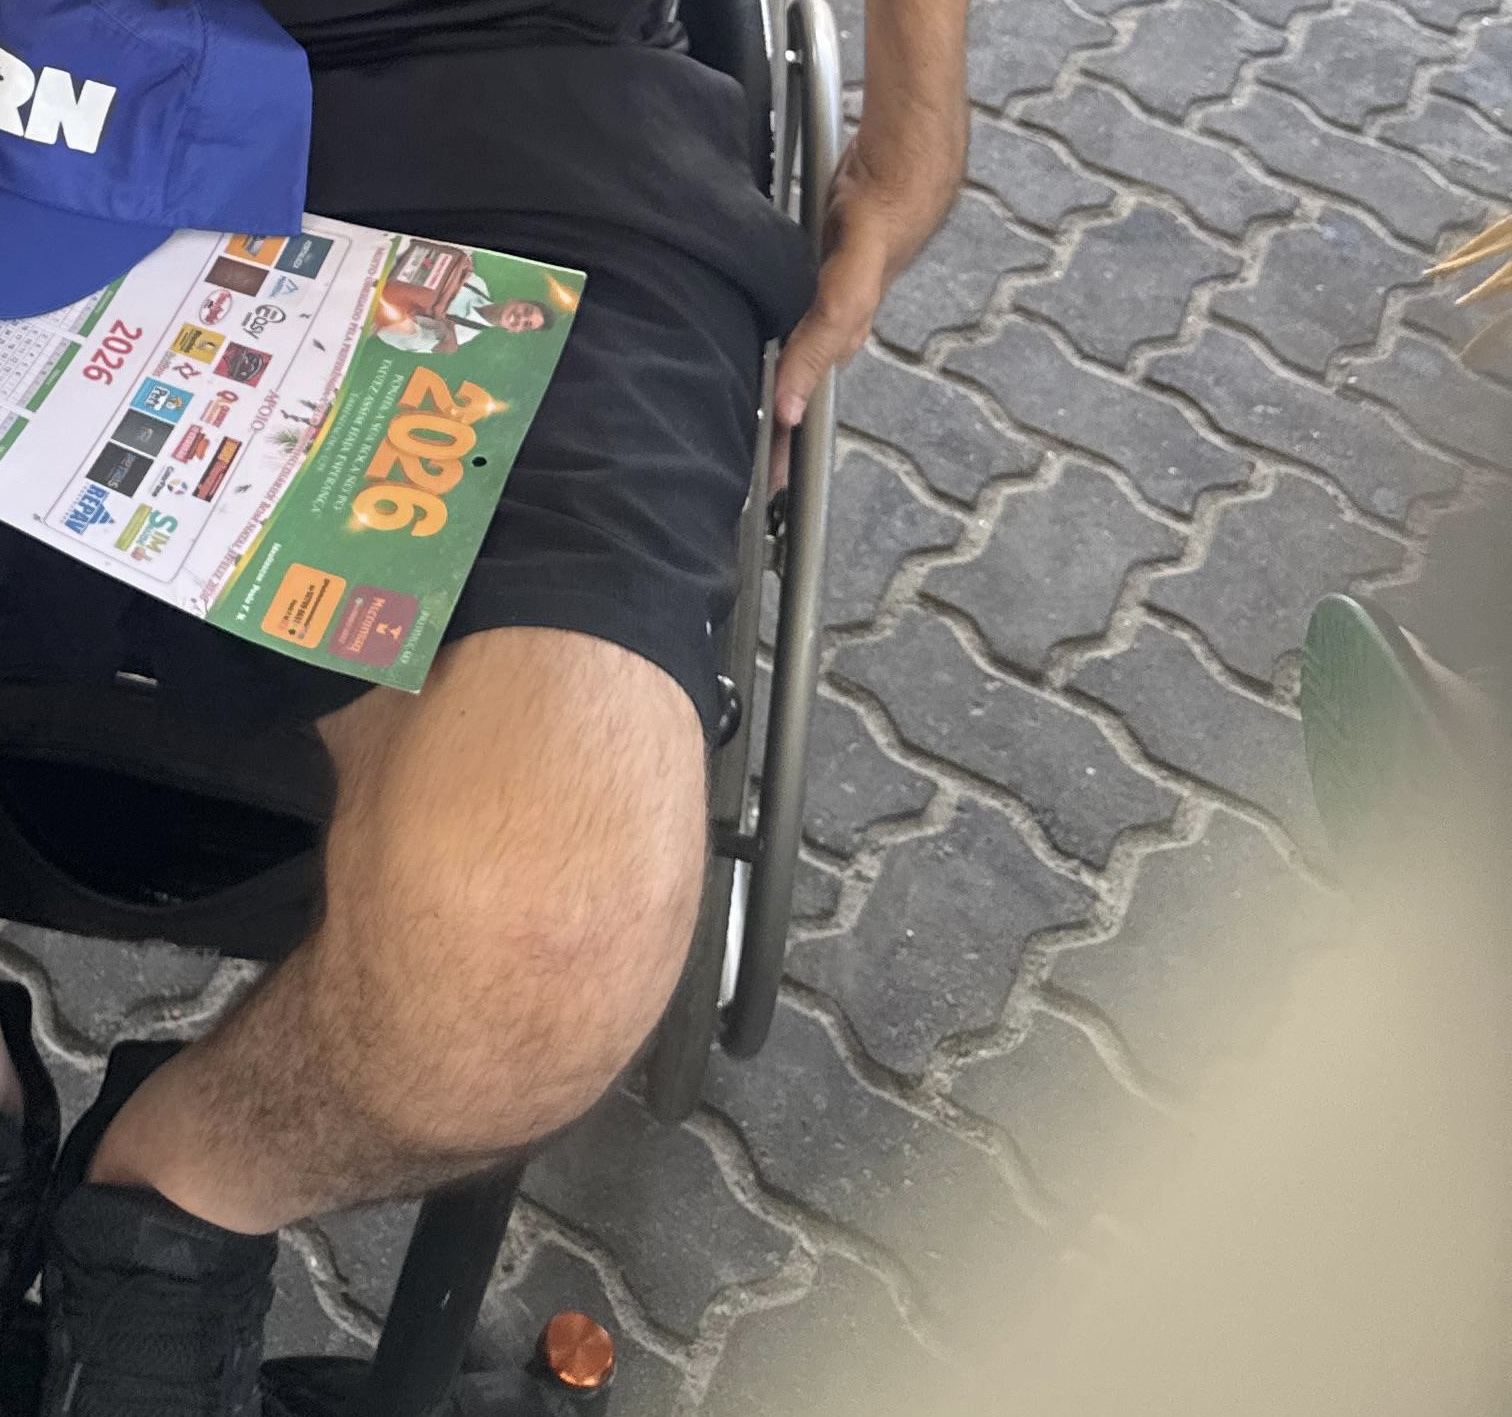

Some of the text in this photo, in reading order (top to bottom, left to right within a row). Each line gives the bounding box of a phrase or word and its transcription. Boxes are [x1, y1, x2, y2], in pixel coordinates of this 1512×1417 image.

[82, 320, 143, 387] 2026
[351, 365, 496, 538] 2026
[64, 483, 109, 535] REPAV
